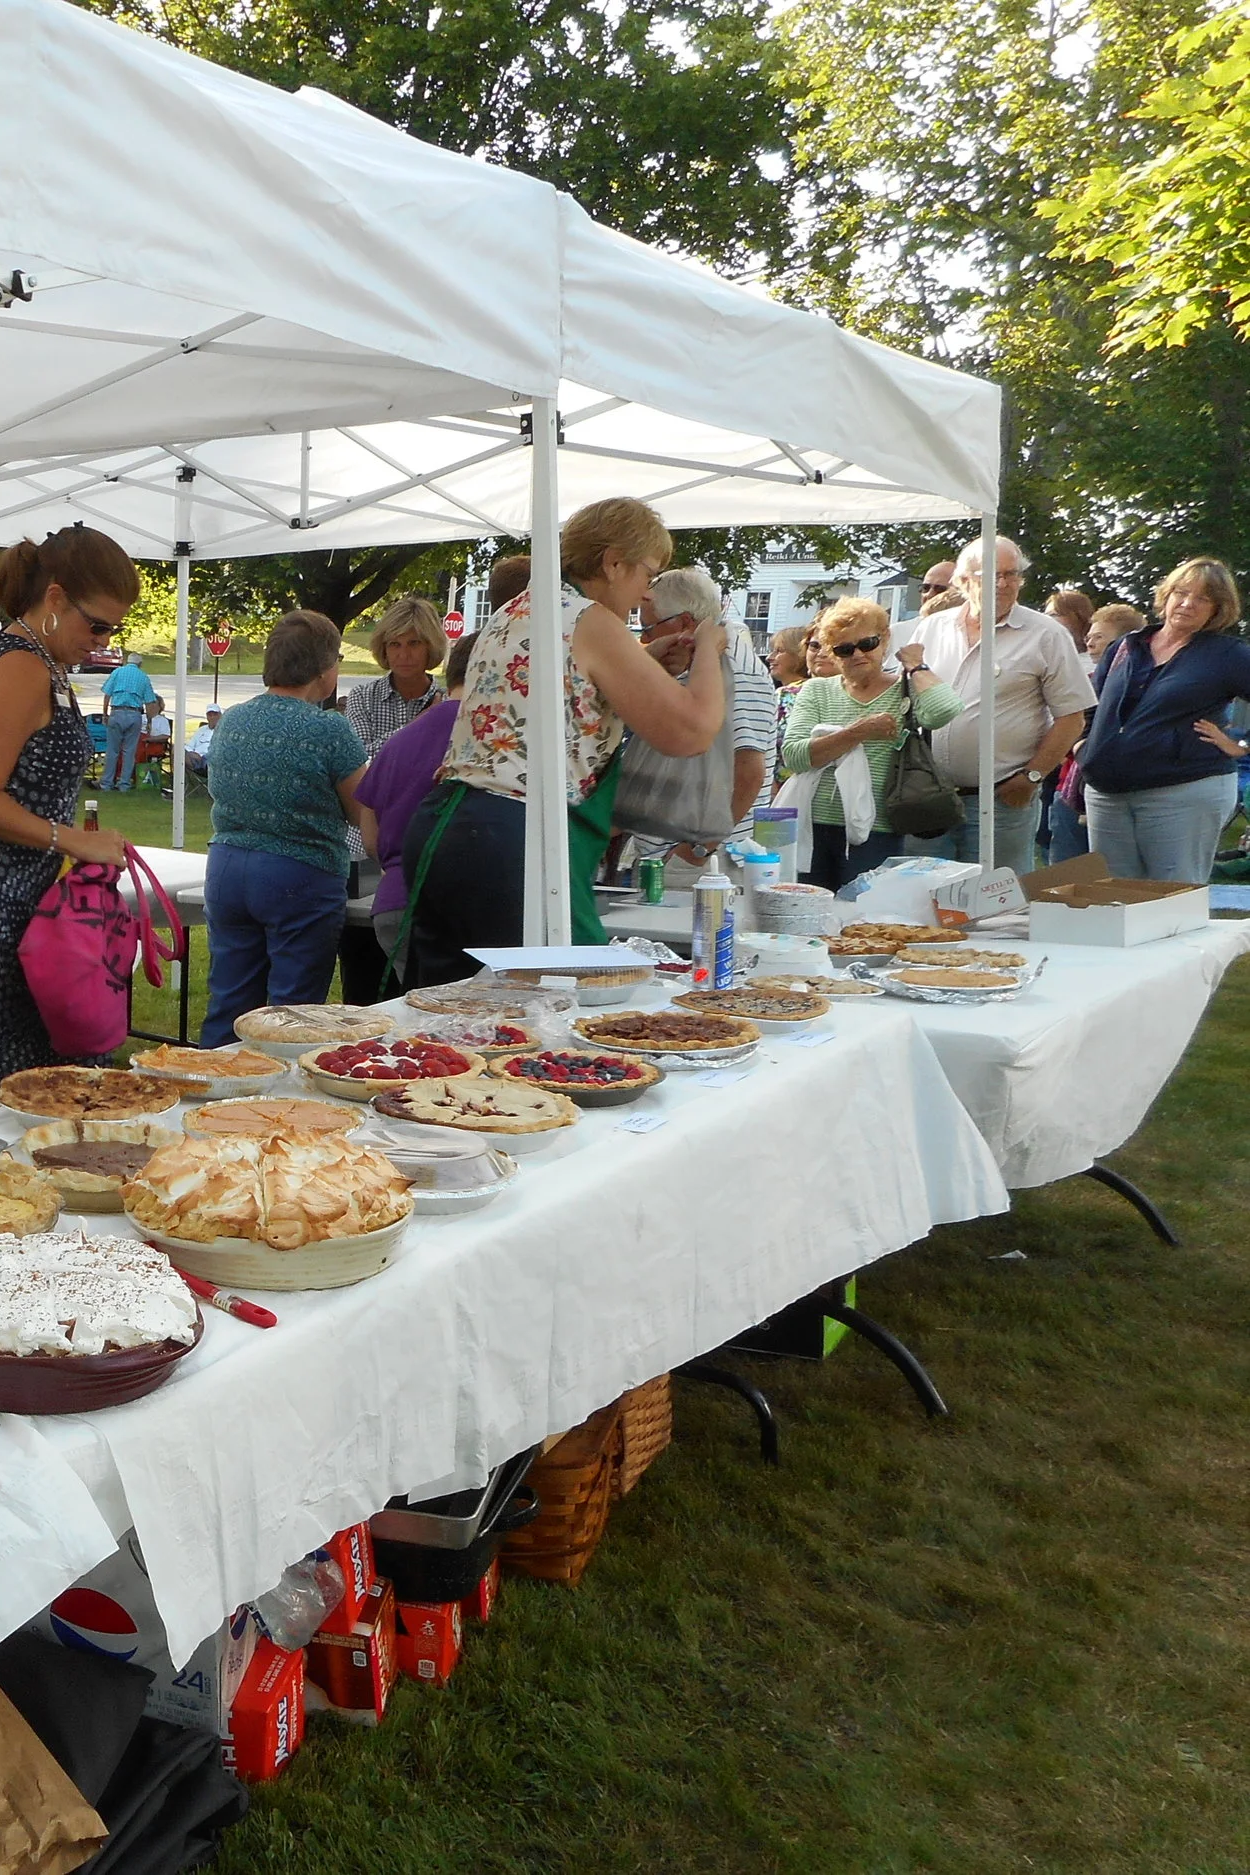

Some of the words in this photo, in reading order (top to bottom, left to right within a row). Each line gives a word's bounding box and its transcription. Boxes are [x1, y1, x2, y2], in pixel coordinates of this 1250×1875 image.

[445, 620, 463, 631] STOP
[350, 1531, 367, 1603] MOXIE
[172, 1668, 204, 1693] 24
[274, 1696, 290, 1768] MOXIE
